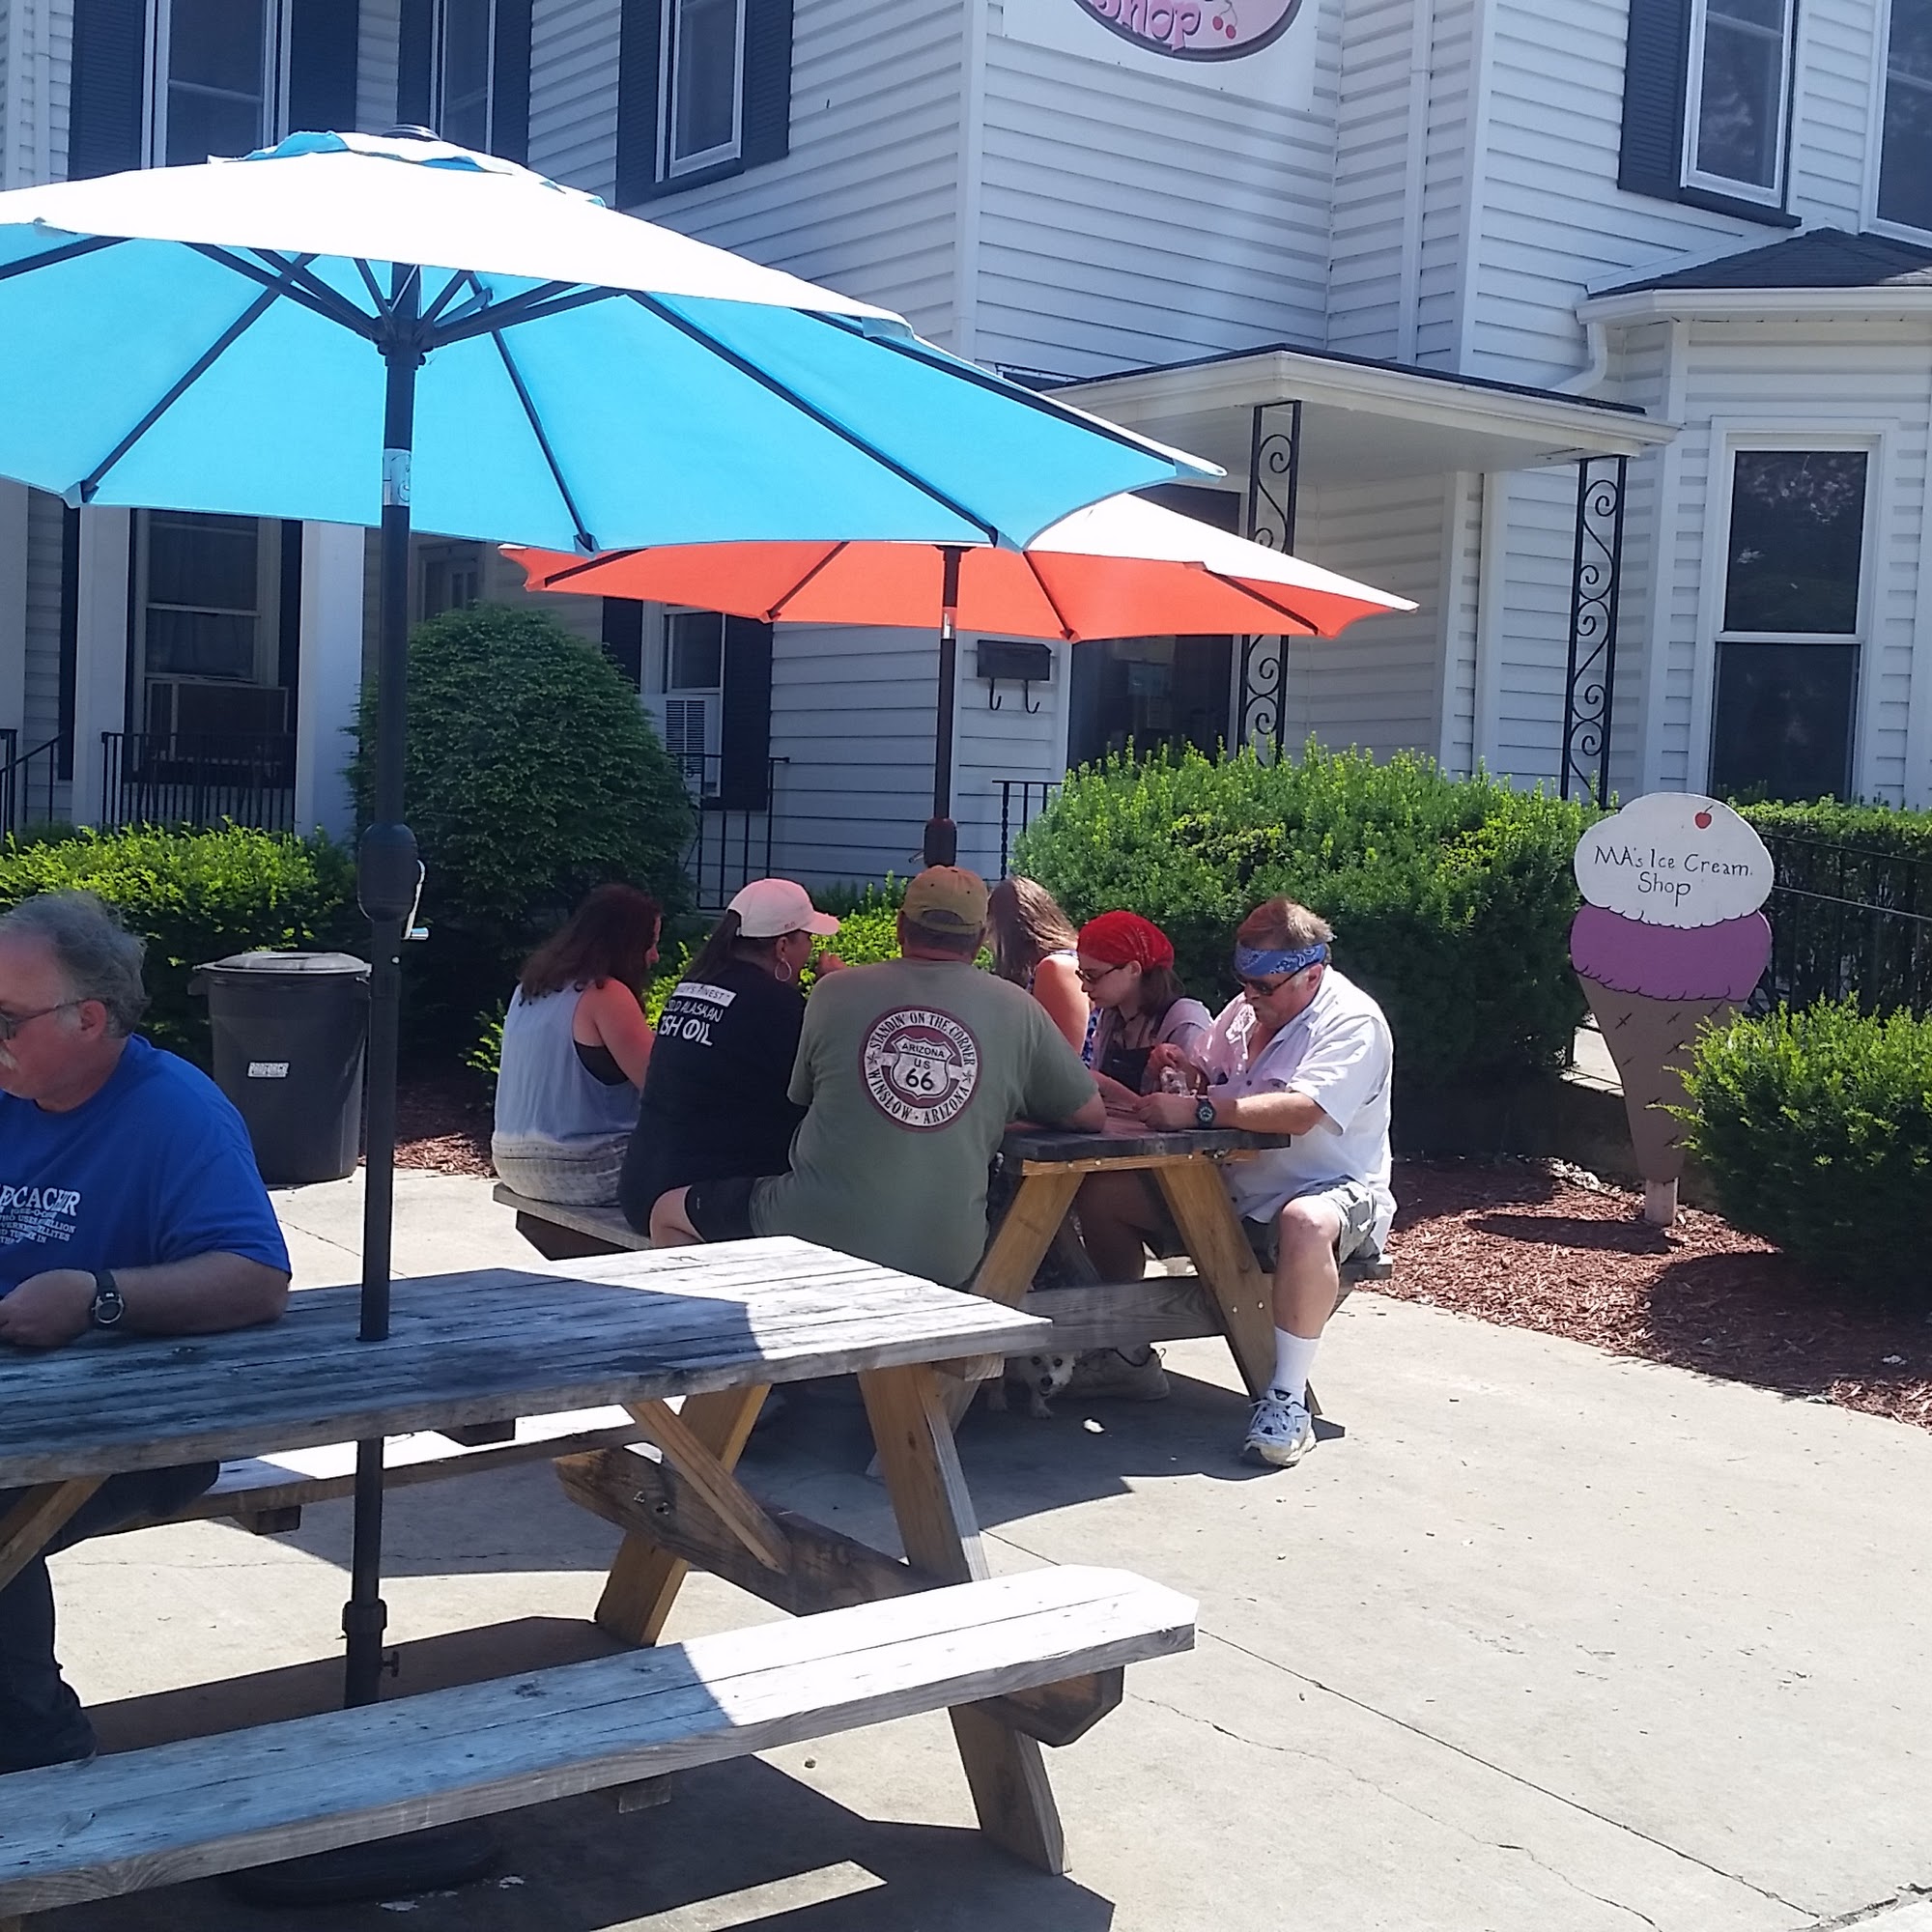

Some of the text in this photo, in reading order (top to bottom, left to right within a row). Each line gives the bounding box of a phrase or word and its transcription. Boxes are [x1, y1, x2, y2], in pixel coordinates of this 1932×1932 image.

[1650, 848, 1675, 868] Ice
[1637, 871, 1691, 907] Shop
[682, 1018, 713, 1046] OIL
[909, 1012, 925, 1024] ON
[928, 1014, 951, 1031] THE
[949, 1025, 976, 1065] CORNER
[901, 1042, 945, 1058] ARIZONA
[913, 1058, 931, 1070] US
[905, 1067, 934, 1092] 66
[867, 1068, 970, 1124] WINSLOW ARIZONA
